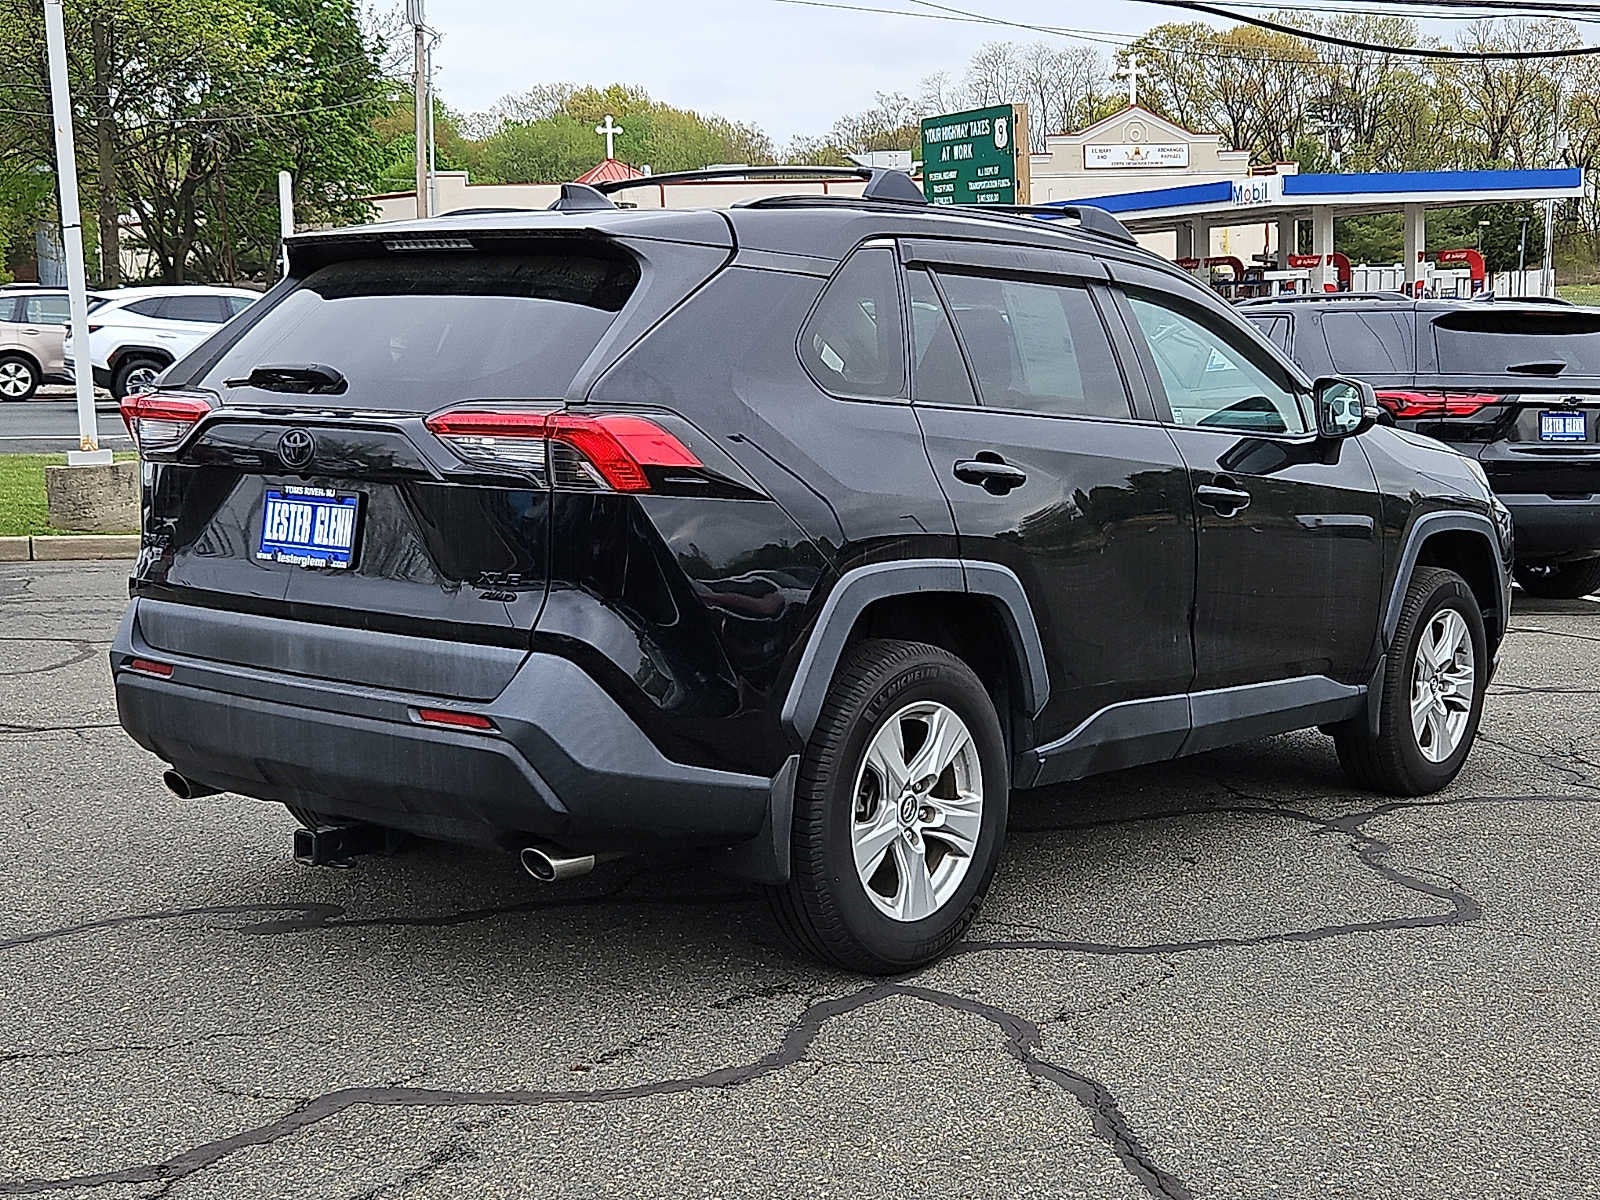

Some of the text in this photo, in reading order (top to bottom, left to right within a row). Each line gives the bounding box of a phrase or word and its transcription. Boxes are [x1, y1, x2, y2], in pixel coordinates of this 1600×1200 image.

[970, 119, 990, 136] TAXES
[942, 143, 973, 161] AT WORK
[1233, 182, 1268, 203] Mobil
[285, 485, 304, 495] TOMS
[264, 501, 354, 548] LESTER GLENN
[477, 571, 521, 585] XLE
[478, 591, 518, 603] AWD
